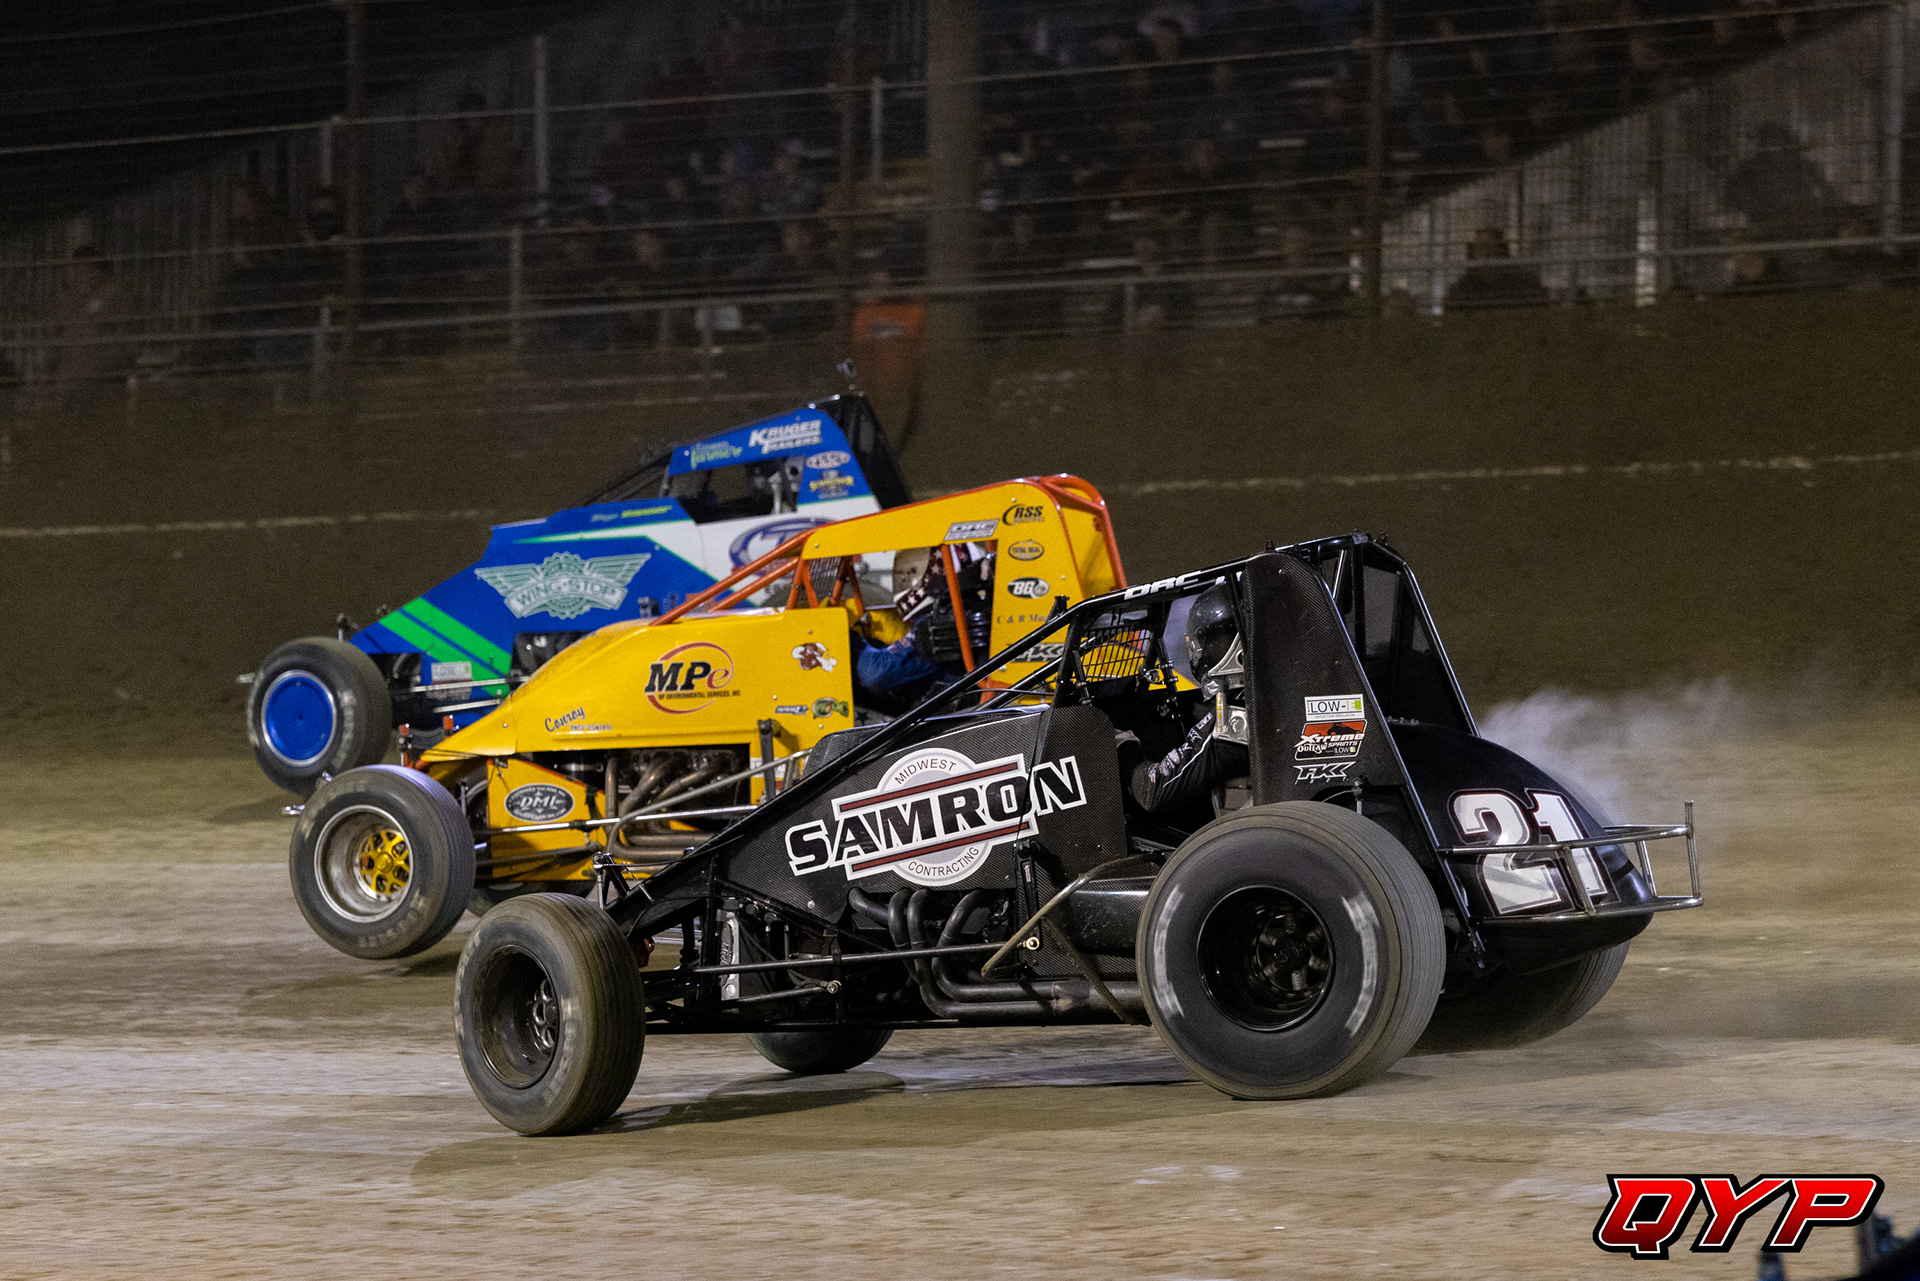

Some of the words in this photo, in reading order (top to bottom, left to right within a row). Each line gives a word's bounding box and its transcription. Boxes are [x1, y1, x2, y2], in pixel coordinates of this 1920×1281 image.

[749, 420, 821, 447] KRUGER
[1014, 506, 1043, 518] RSS
[644, 660, 730, 693] MPe
[544, 706, 586, 732] Conroy
[894, 758, 957, 785] MIDWEST
[786, 757, 1086, 876] SAMRON
[908, 846, 979, 878] CONTRACTING
[1451, 790, 1612, 915] 21
